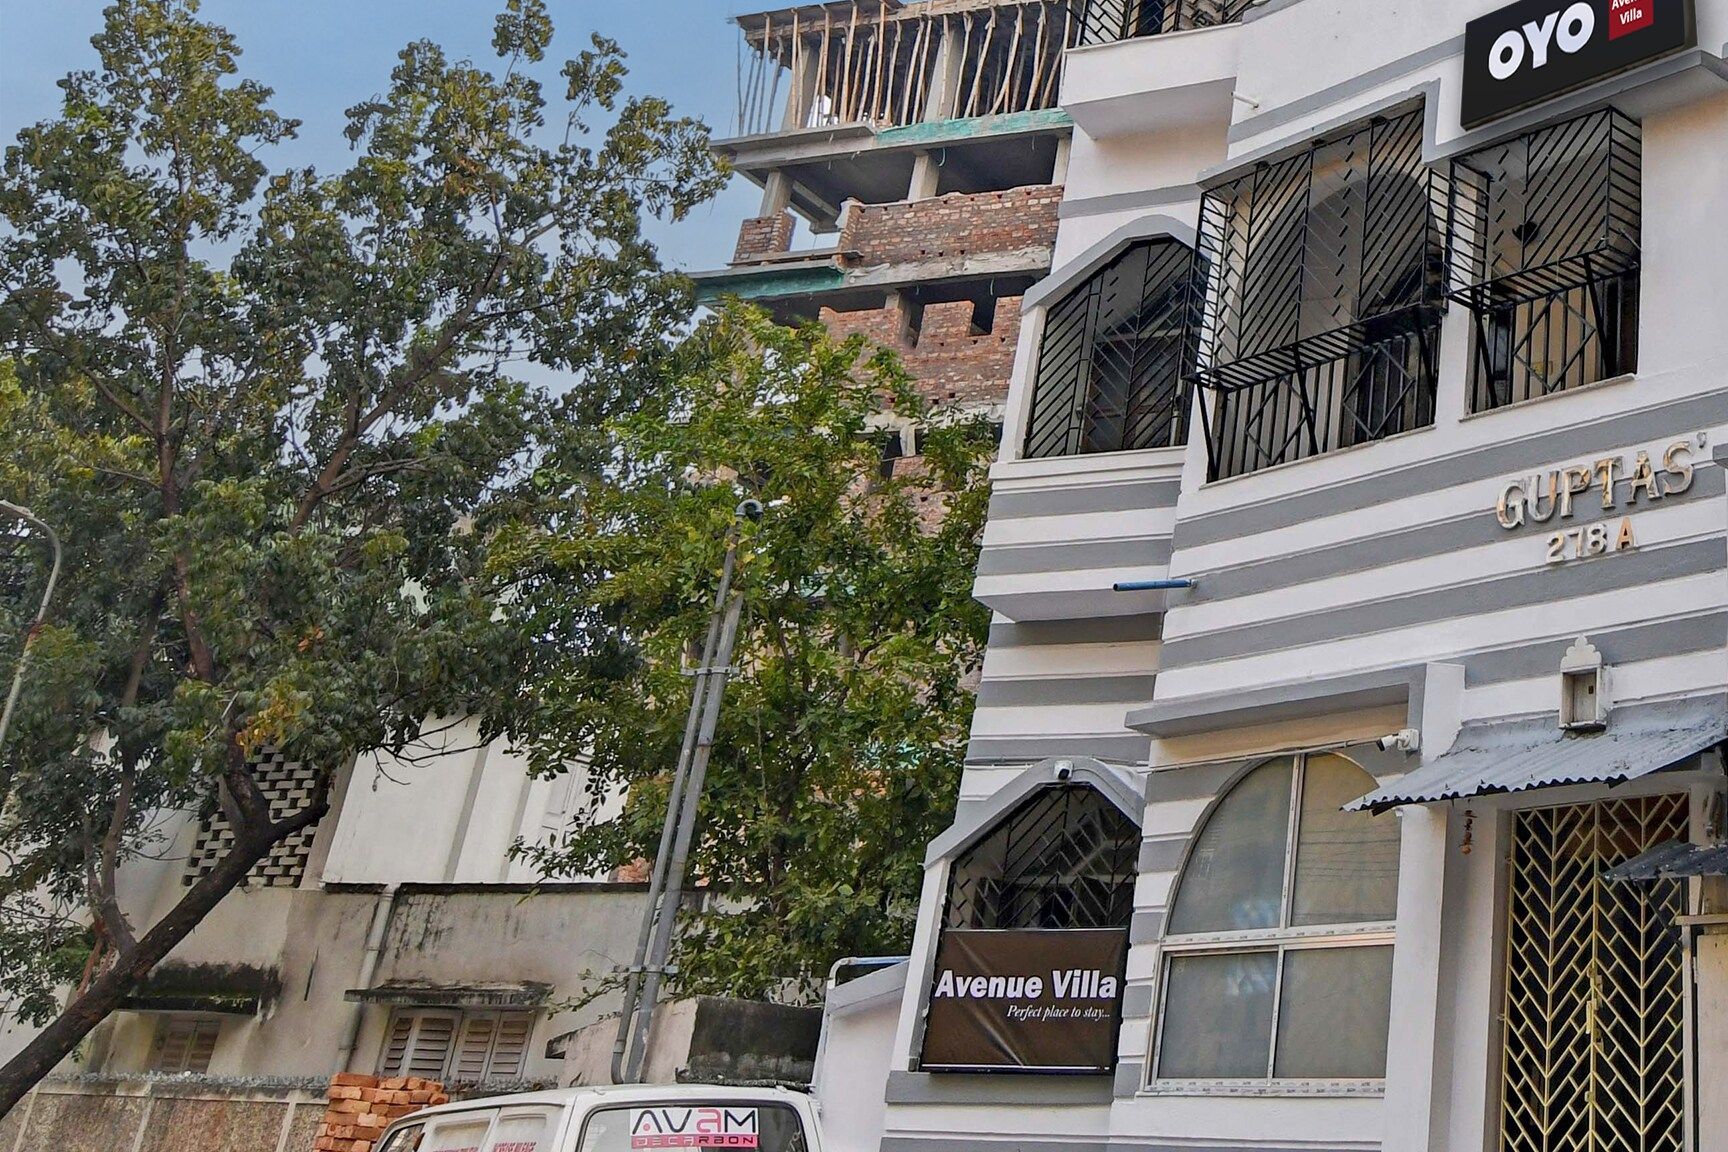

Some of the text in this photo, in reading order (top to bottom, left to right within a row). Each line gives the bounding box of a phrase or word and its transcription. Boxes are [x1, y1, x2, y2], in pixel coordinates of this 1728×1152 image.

[1619, 7, 1643, 25] Villa
[1488, 1, 1595, 81] OYO
[934, 969, 1117, 999] Avenue Villa
[1007, 1004, 1042, 1021] Perfect
[1041, 1004, 1069, 1022] place
[1071, 1006, 1081, 1017] to
[636, 1136, 754, 1146] DECARBON
